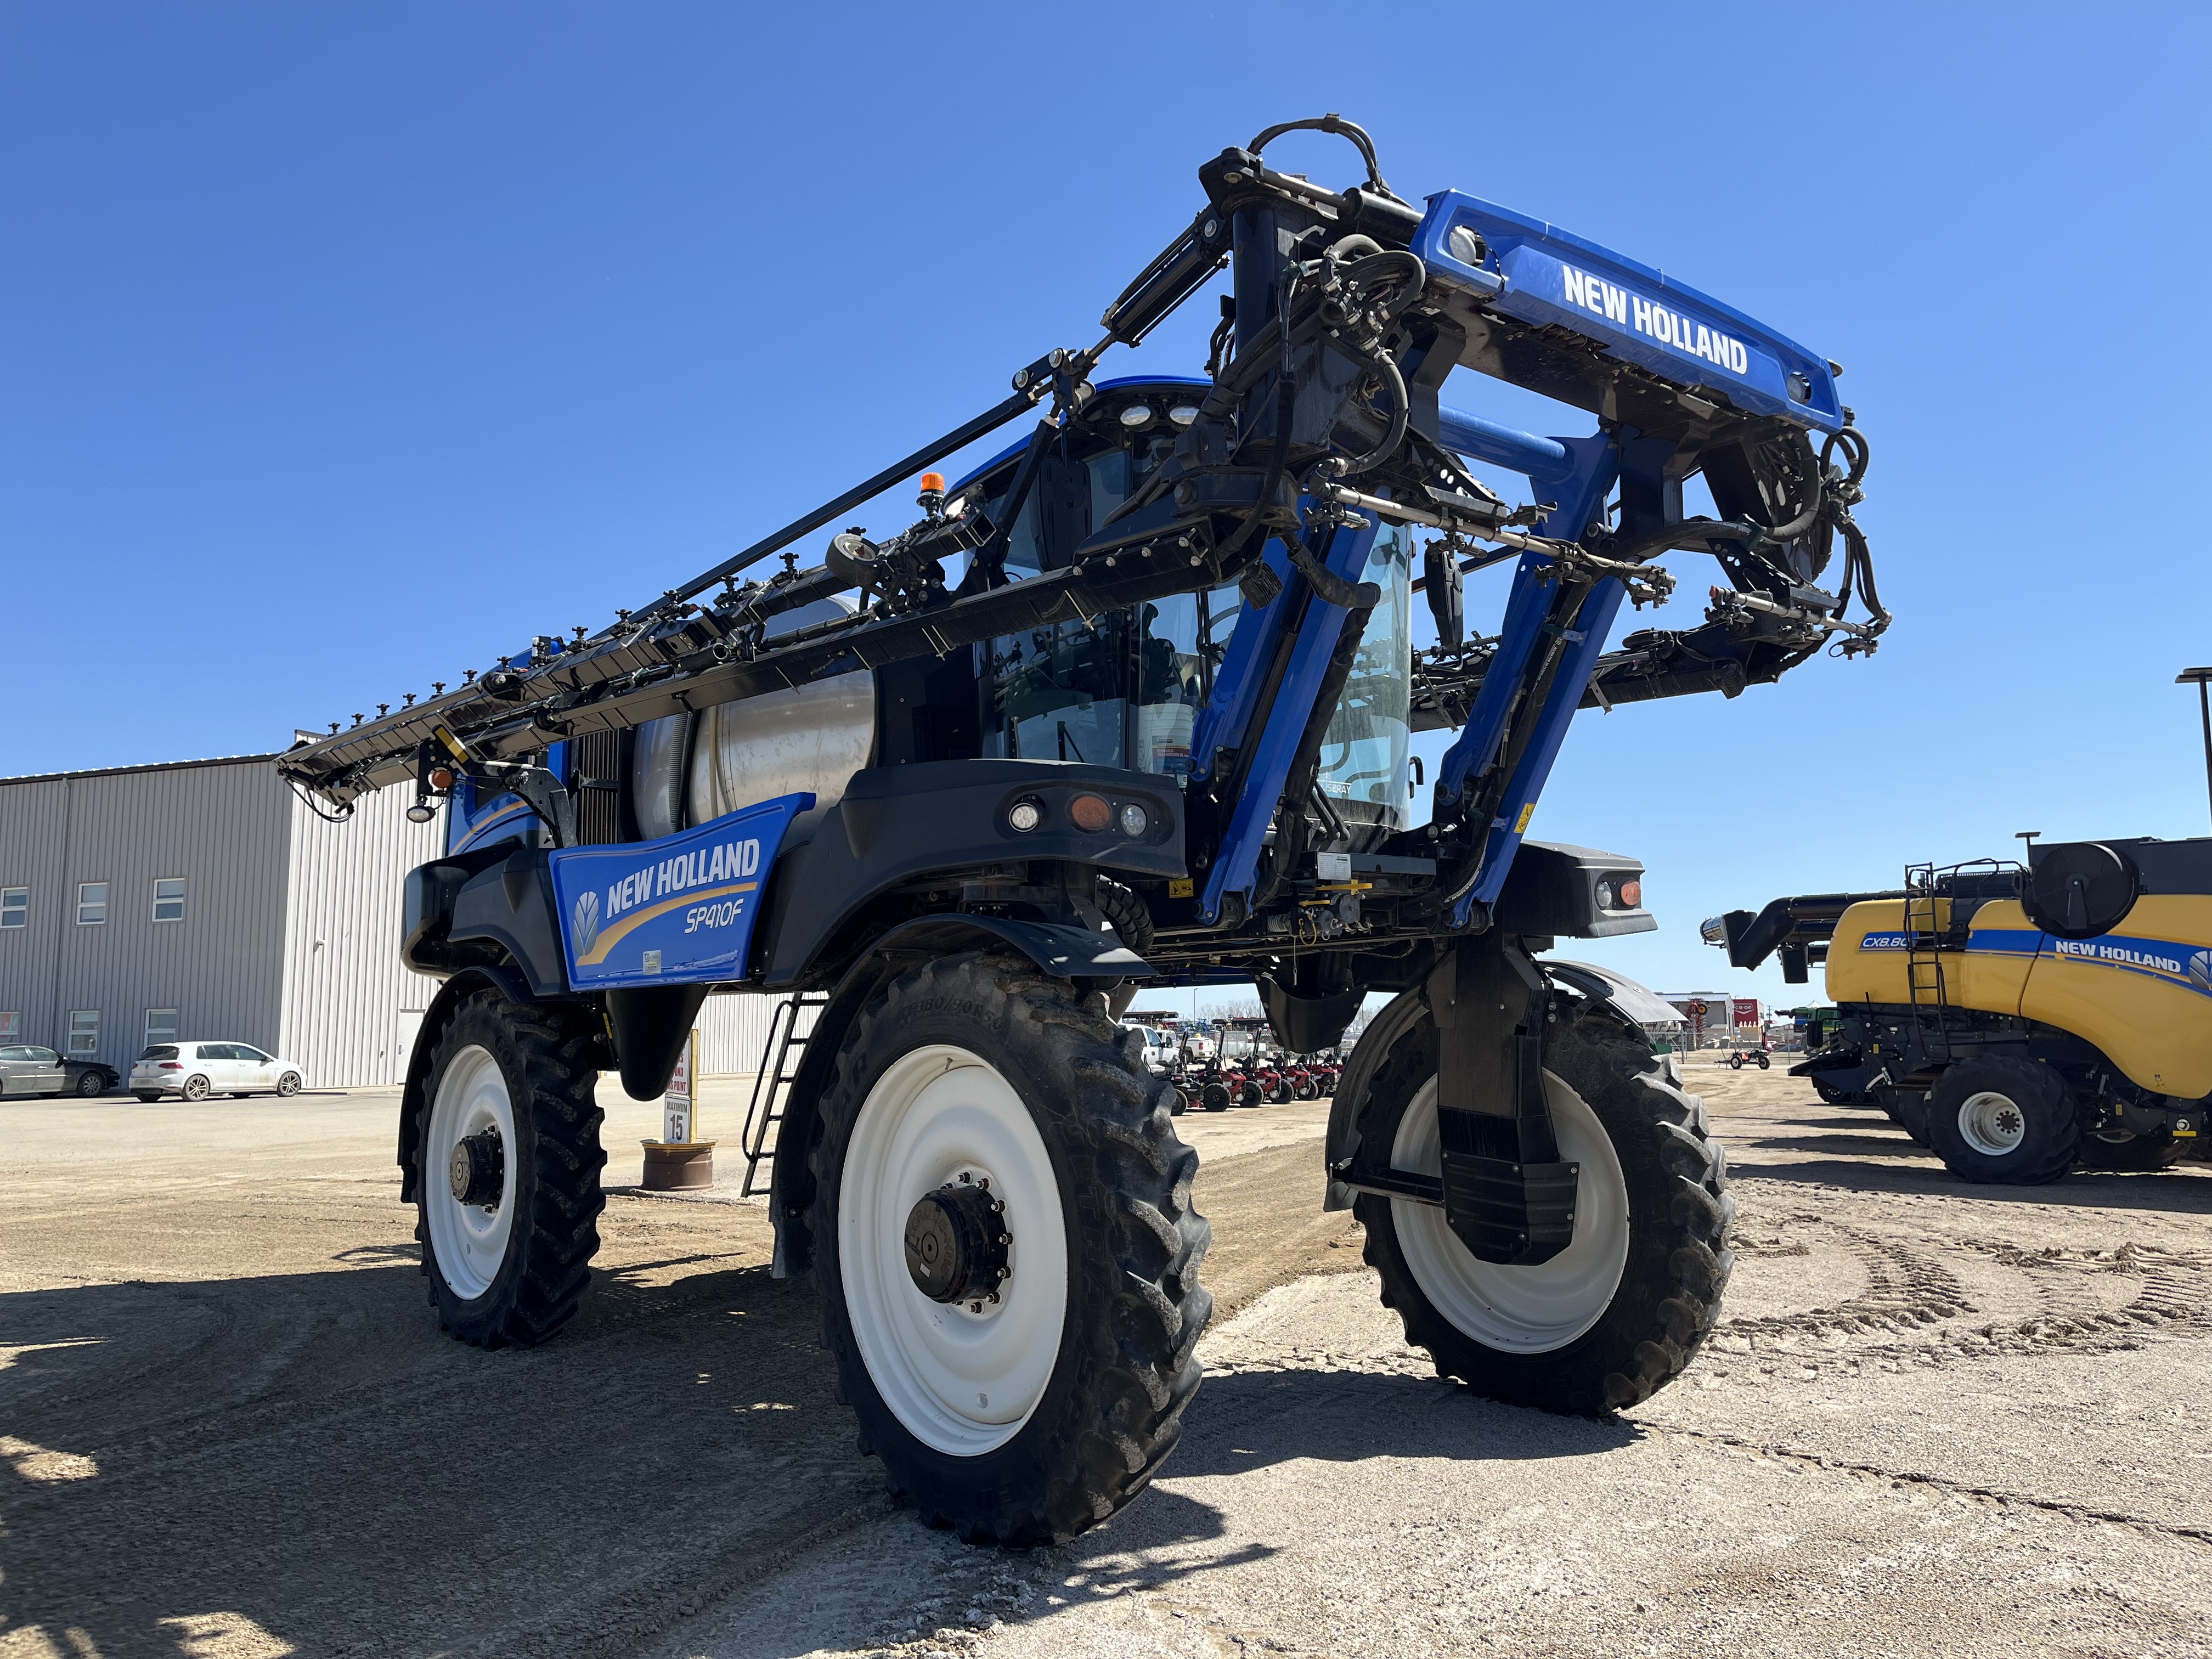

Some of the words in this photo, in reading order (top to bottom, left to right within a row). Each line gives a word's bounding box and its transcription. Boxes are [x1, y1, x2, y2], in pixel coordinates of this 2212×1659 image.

[1563, 265, 1626, 325] NEW
[1632, 296, 1747, 375] HOLLAND
[607, 865, 654, 919] NEW
[657, 838, 759, 896] HOLLAND
[684, 899, 744, 934] SP410F
[2056, 941, 2096, 956] NEW
[2100, 946, 2181, 973] HOLLAND
[674, 1081, 686, 1092] POINT
[667, 1101, 687, 1113] MAXIMUM
[670, 1114, 683, 1141] 15
